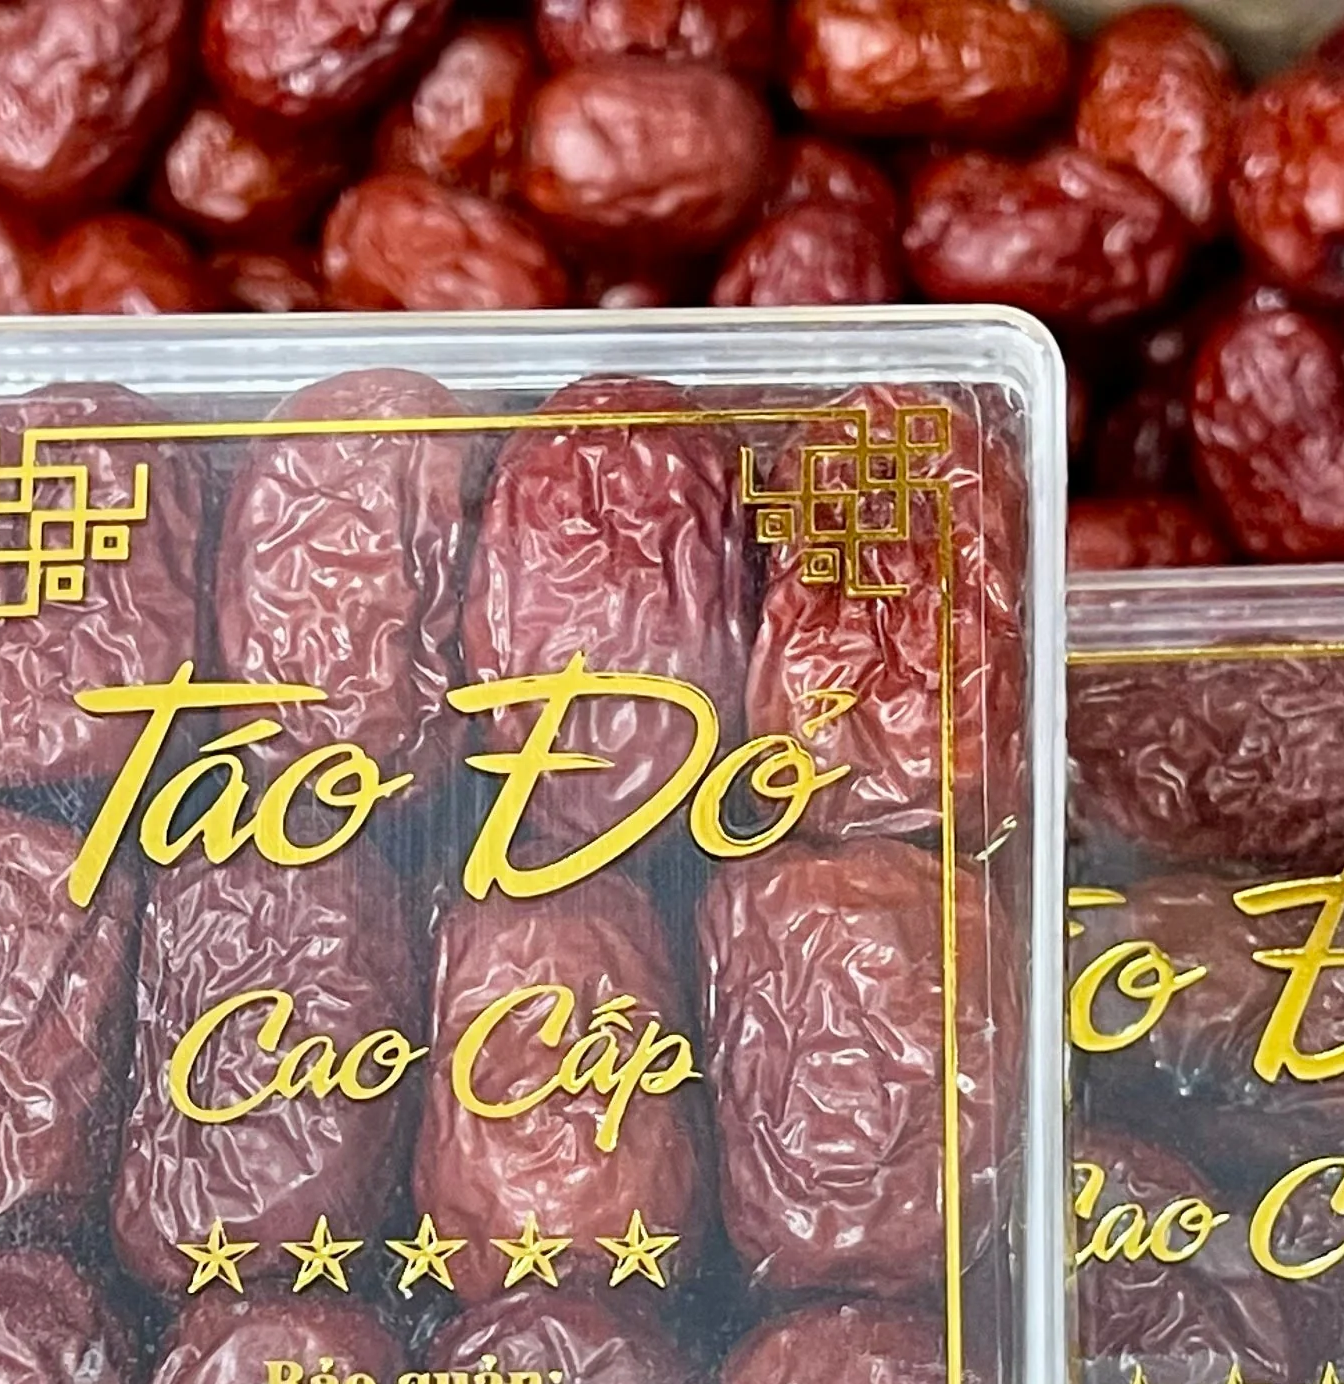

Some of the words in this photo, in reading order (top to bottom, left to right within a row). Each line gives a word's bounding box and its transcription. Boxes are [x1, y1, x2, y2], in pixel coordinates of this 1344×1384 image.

[69, 661, 414, 908] Táo
[448, 651, 860, 900] Đỏ
[169, 989, 429, 1125] Cao
[451, 984, 703, 1152] Cấp
